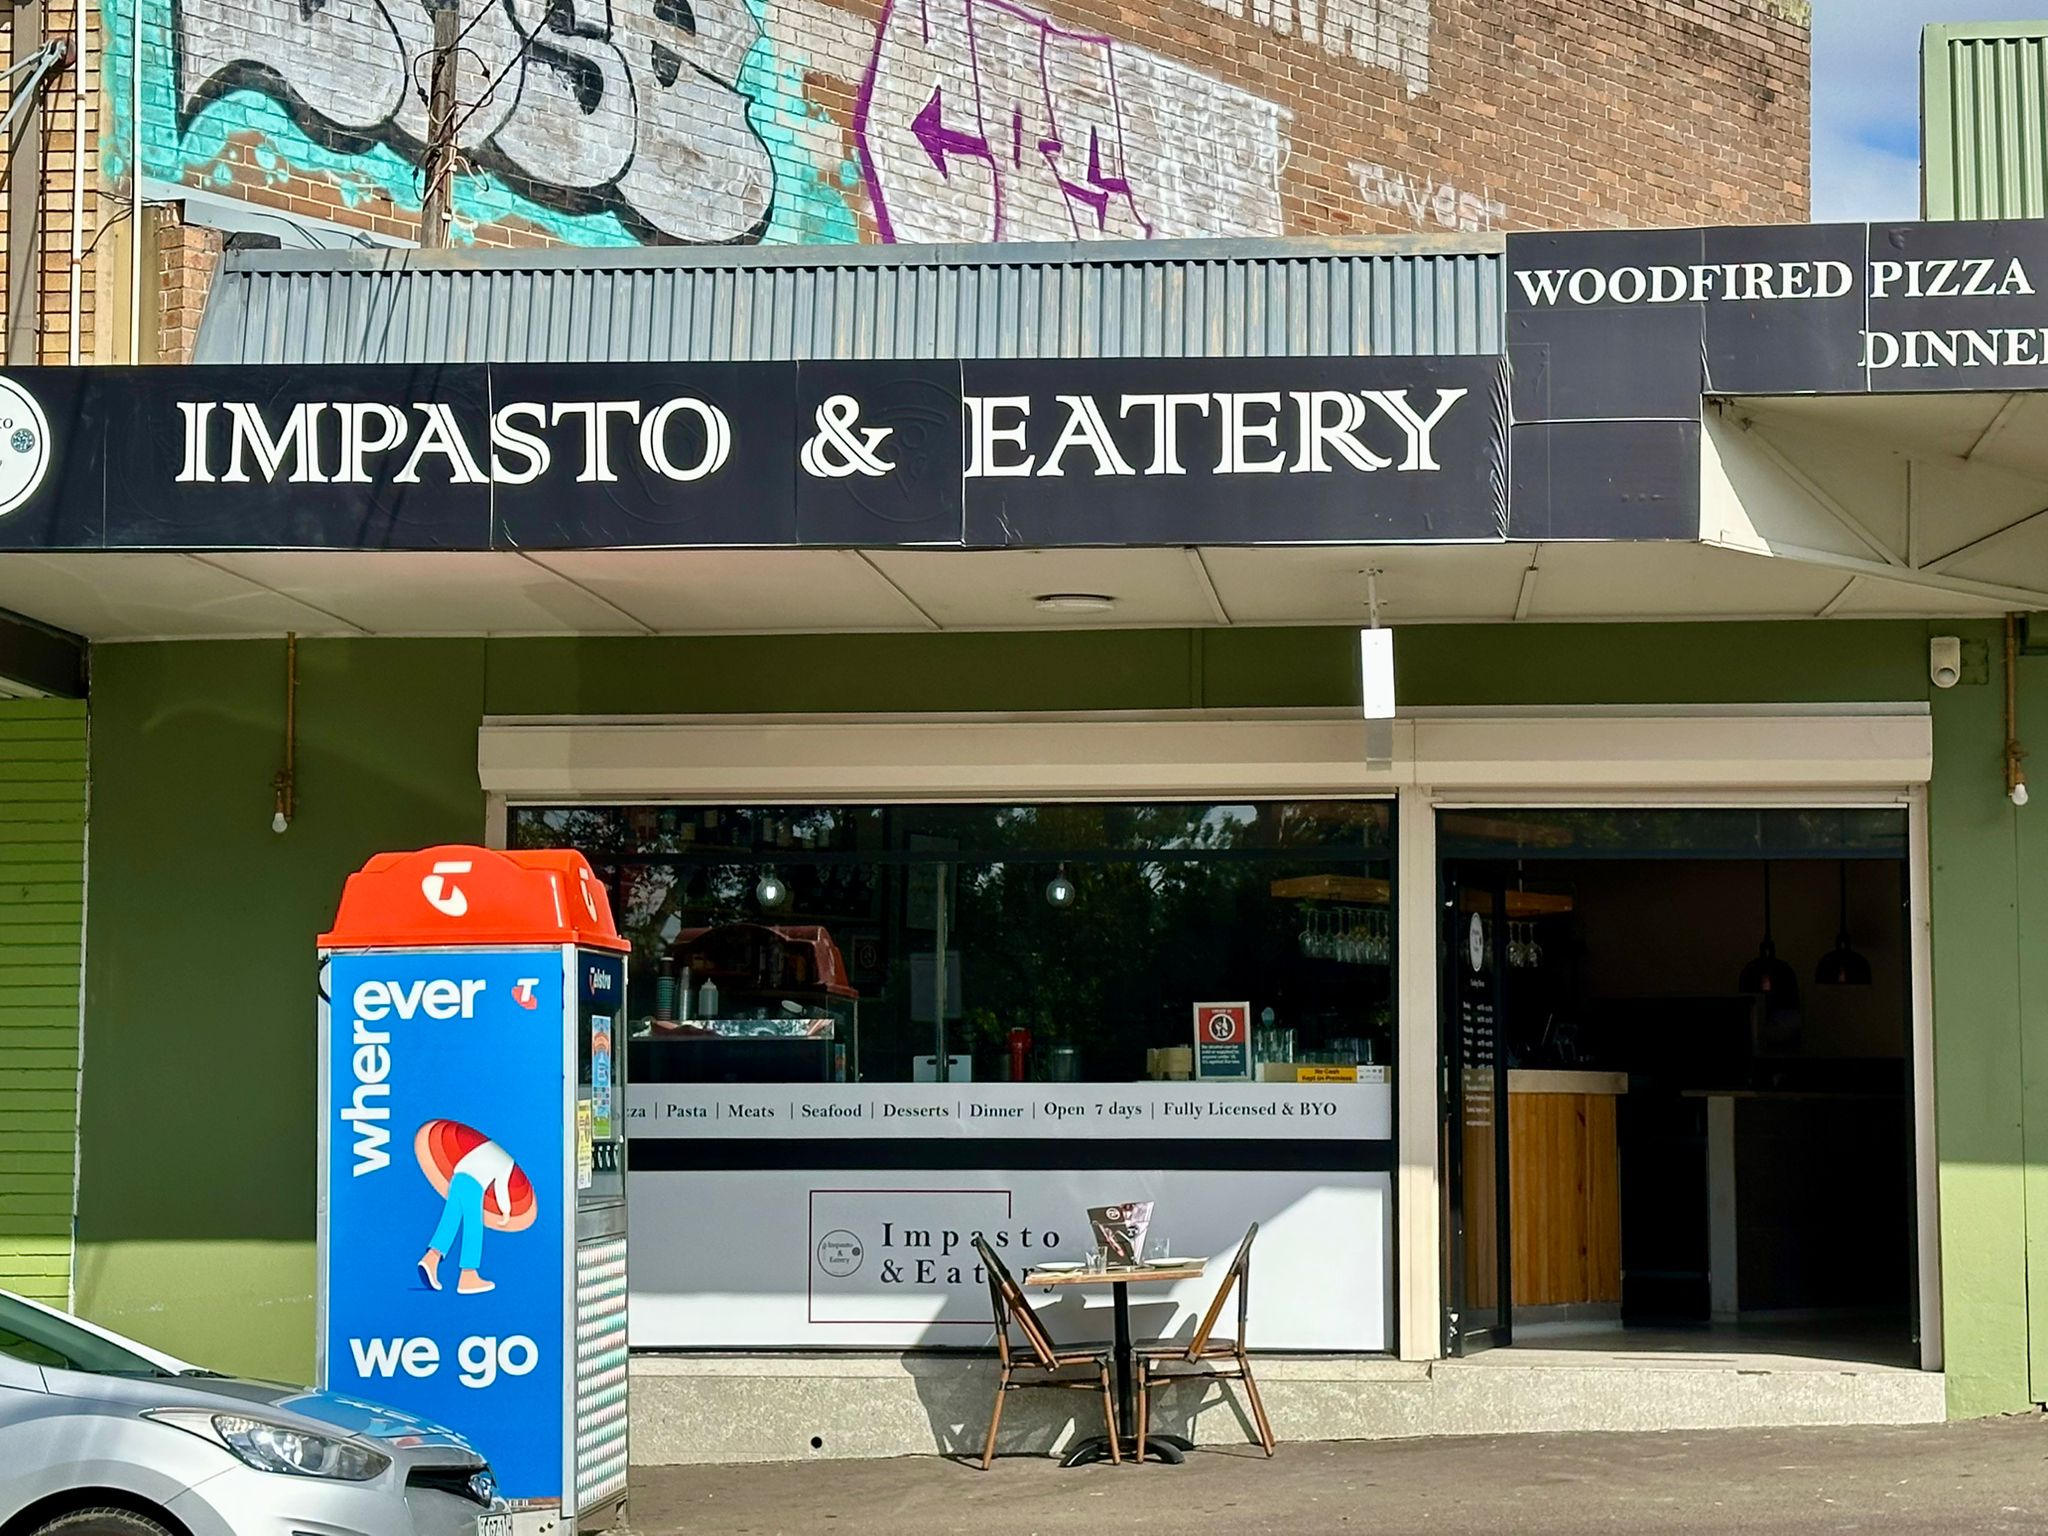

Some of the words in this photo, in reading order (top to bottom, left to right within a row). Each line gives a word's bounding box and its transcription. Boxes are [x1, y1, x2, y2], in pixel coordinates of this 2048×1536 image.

[1514, 261, 1853, 306] WOODFIRED
[1870, 258, 2036, 298] PIZZA
[175, 397, 731, 484] IMPASTO
[800, 394, 896, 477] &
[963, 388, 1468, 477] EATERY
[666, 1104, 708, 1118] Pasta
[728, 1104, 776, 1118] Meats
[801, 1103, 863, 1118] Seafood
[883, 1103, 950, 1118] Desserts
[970, 1103, 1024, 1118] Dinner
[1044, 1101, 1086, 1120] Open
[1095, 1103, 1103, 1116] 7
[1108, 1101, 1143, 1121] days
[1163, 1101, 1203, 1120] Fully
[1207, 1101, 1276, 1116] Licensed
[1281, 1102, 1295, 1116] &
[1299, 1102, 1337, 1116] BYO
[881, 1222, 1060, 1255] Impasto
[349, 1336, 440, 1378] we
[458, 1335, 539, 1388] go
